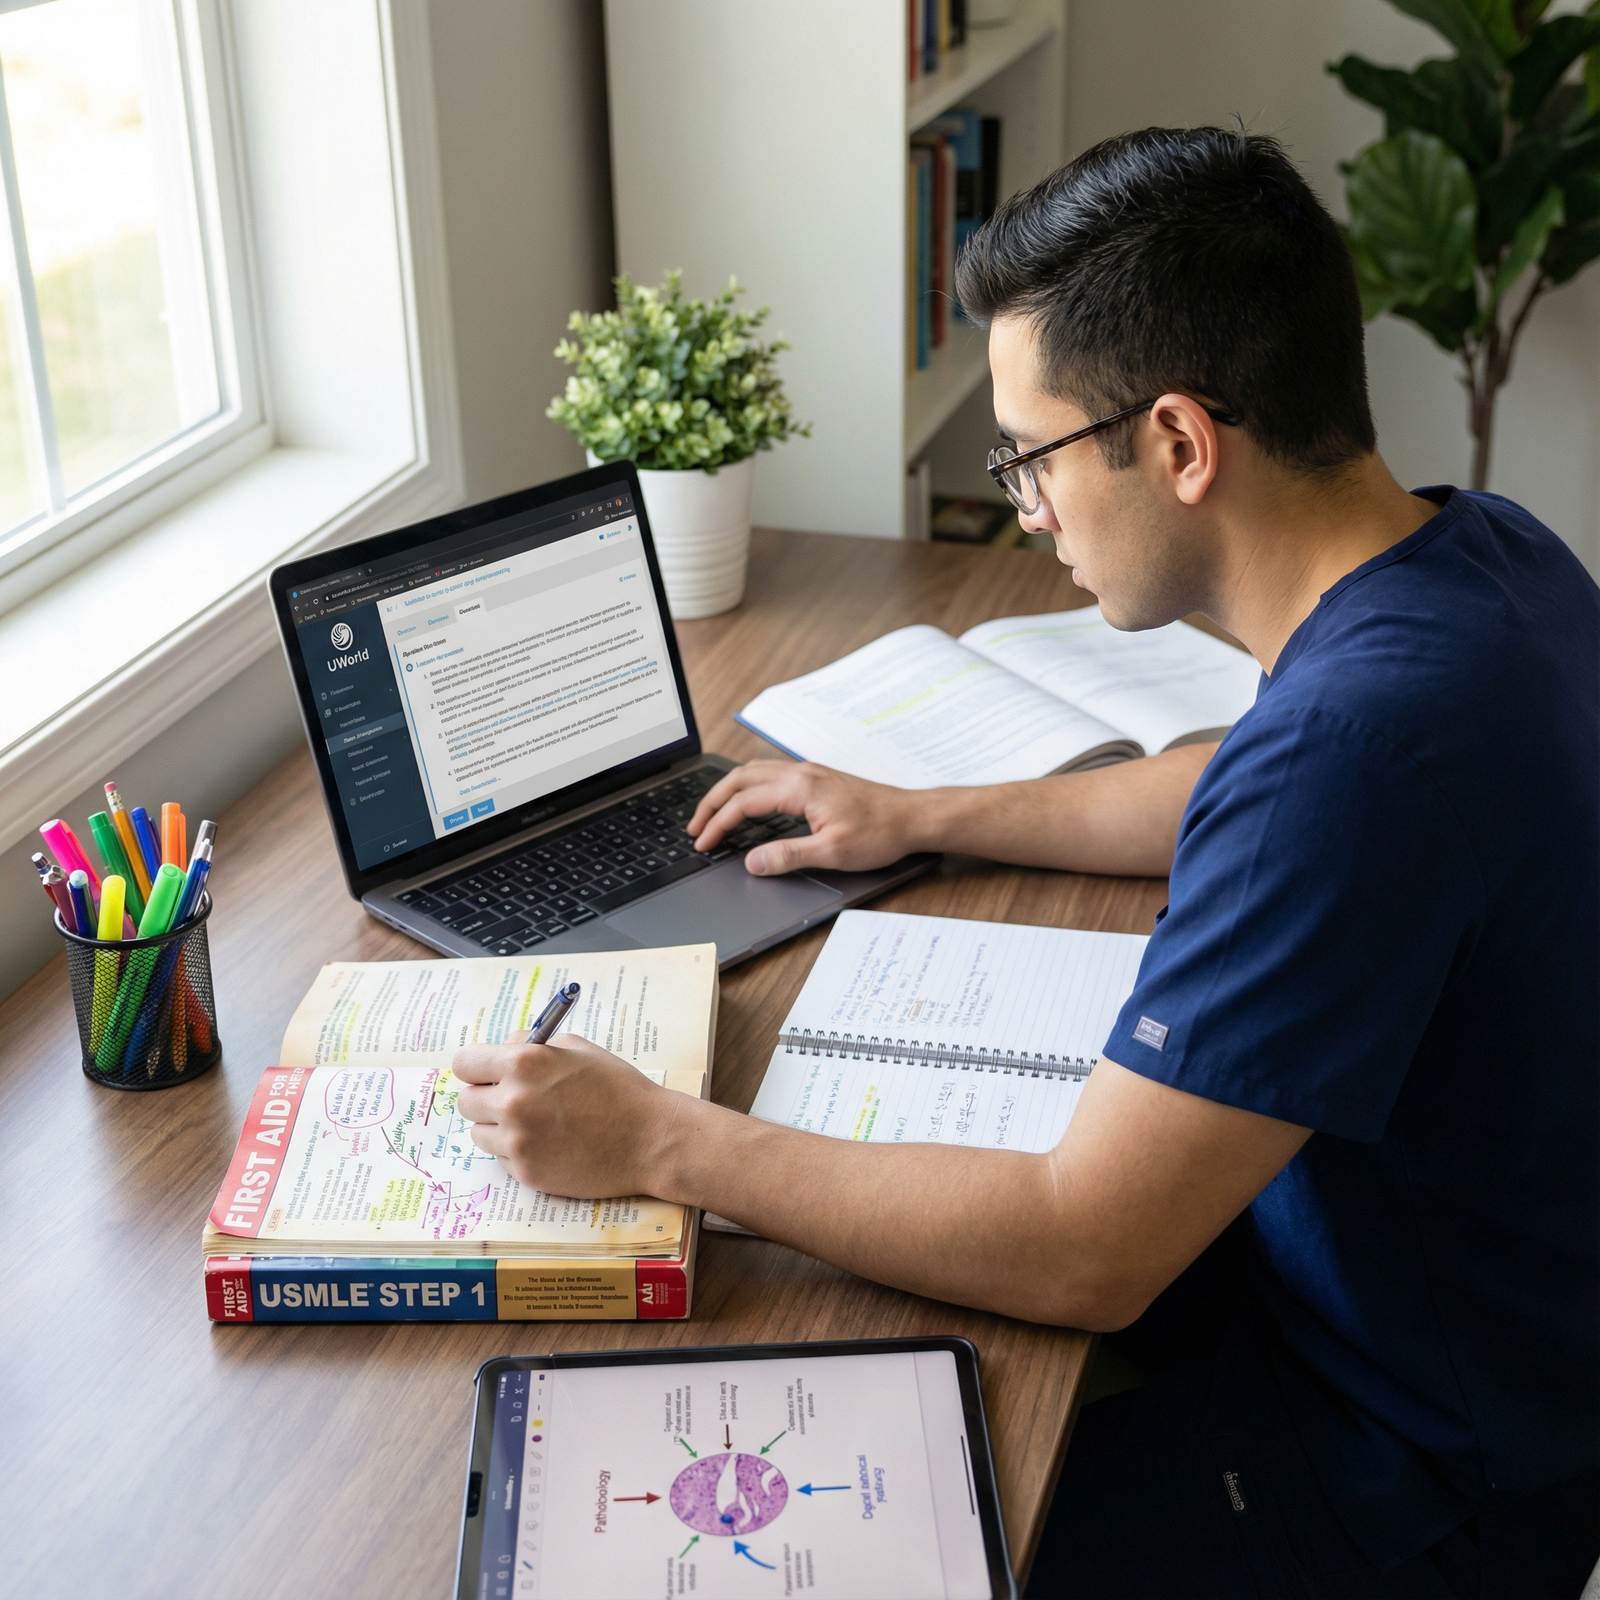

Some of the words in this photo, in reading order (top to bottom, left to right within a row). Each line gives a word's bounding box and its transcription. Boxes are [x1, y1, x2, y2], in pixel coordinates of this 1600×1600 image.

[327, 647, 370, 672] UWorld
[268, 1074, 288, 1096] FOR
[255, 1098, 292, 1147] AID
[223, 1150, 278, 1230] FIRST
[222, 1278, 236, 1318] FIRST
[235, 1290, 248, 1314] AID
[259, 1282, 369, 1308] USMLE
[379, 1282, 461, 1307] STEP
[471, 1281, 485, 1307] 1
